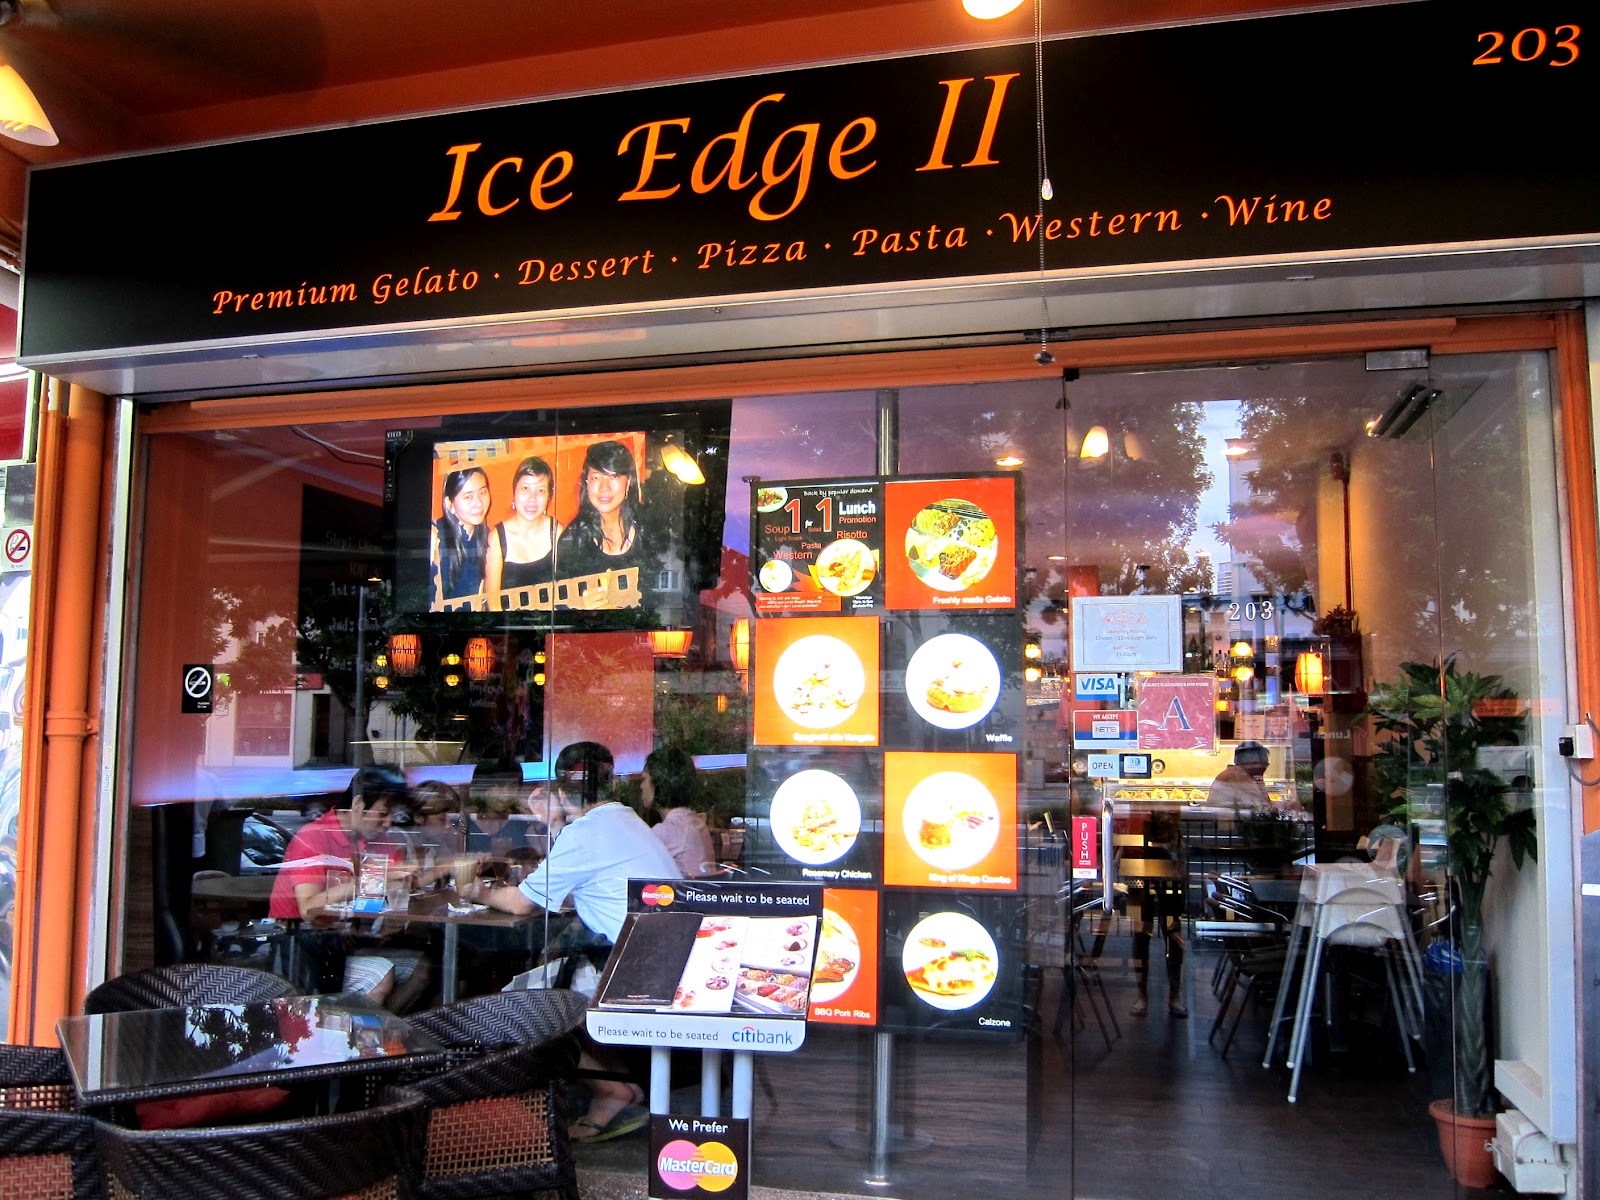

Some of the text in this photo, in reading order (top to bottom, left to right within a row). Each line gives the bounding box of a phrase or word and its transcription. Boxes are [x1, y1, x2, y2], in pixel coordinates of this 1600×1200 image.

[1473, 25, 1580, 66] 203
[428, 73, 1021, 221] Ice Edge II
[212, 193, 1332, 315] Premium Gelato Dessert Pizza Pasta Western Wine
[819, 489, 827, 498] by
[828, 489, 849, 497] popular
[850, 486, 873, 494] demand
[839, 500, 876, 515] Lunch
[784, 498, 801, 533] 1
[815, 497, 832, 532] 1
[839, 516, 877, 524] Promotion
[765, 525, 791, 535] Soup
[836, 530, 868, 539] Risotto
[801, 541, 822, 549] Pasta
[773, 550, 814, 560] Western
[932, 595, 1011, 606] Freshly made Gelato
[1229, 601, 1273, 620] 203
[1081, 677, 1115, 690] VISA
[1157, 696, 1194, 731] A
[986, 733, 1013, 742] Waffle
[1092, 761, 1114, 770] OPEN
[1080, 822, 1089, 860] PUSH
[802, 868, 872, 879] Rosemary Chicken
[981, 876, 1011, 884] Combo
[641, 891, 675, 899] MasterCard
[686, 890, 810, 905] Please wait to be seated
[814, 1007, 871, 1018] BBQ Pork Ribs
[978, 1016, 1011, 1027] Calzone
[598, 1026, 719, 1041] Please wait to be seated
[732, 1026, 793, 1045] citibank
[668, 1119, 729, 1134] We Prefer
[659, 1156, 736, 1176] MasterCard
